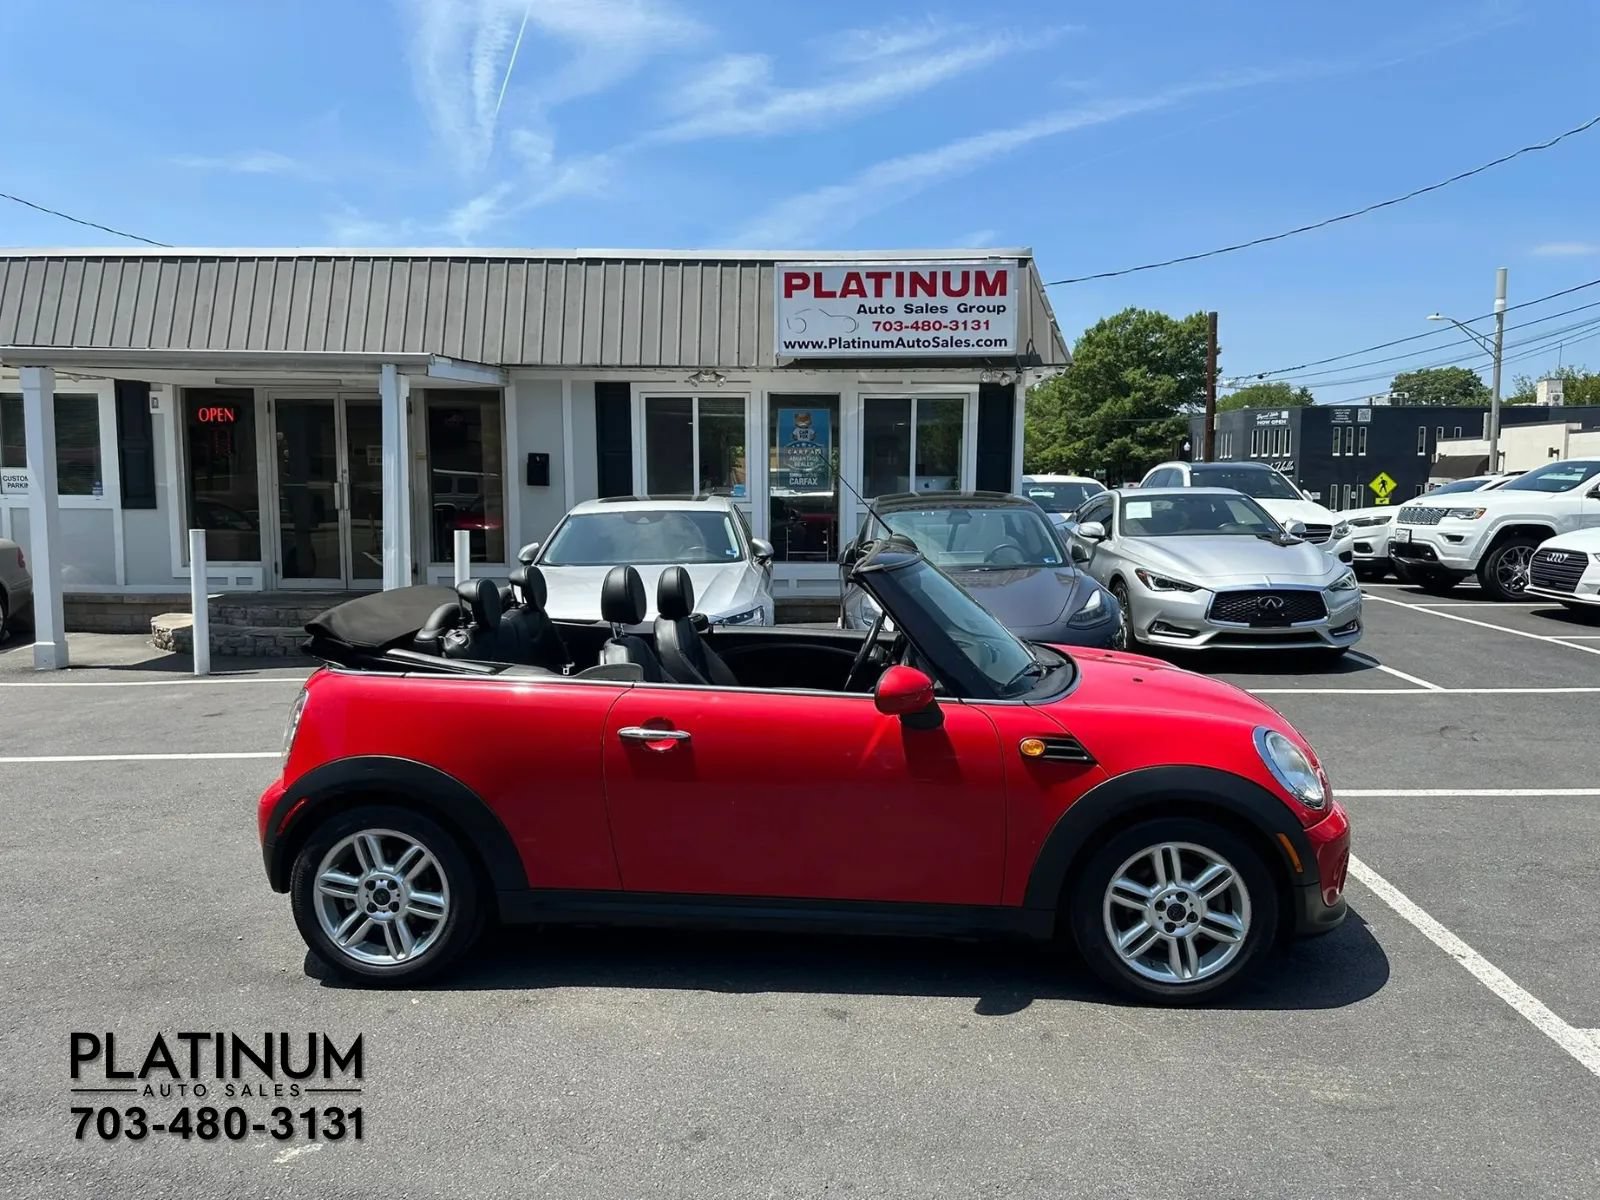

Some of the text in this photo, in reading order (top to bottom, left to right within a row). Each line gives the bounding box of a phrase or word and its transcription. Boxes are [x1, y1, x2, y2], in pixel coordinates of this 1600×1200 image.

[783, 270, 1008, 298] PLATINUM
[856, 303, 1007, 316] Auto Sales Group
[872, 319, 991, 333] 703-480-3131
[783, 335, 1008, 350] www.PlatinumAutoSales.com
[198, 407, 234, 422] OPEN
[789, 477, 818, 486] CARFAX
